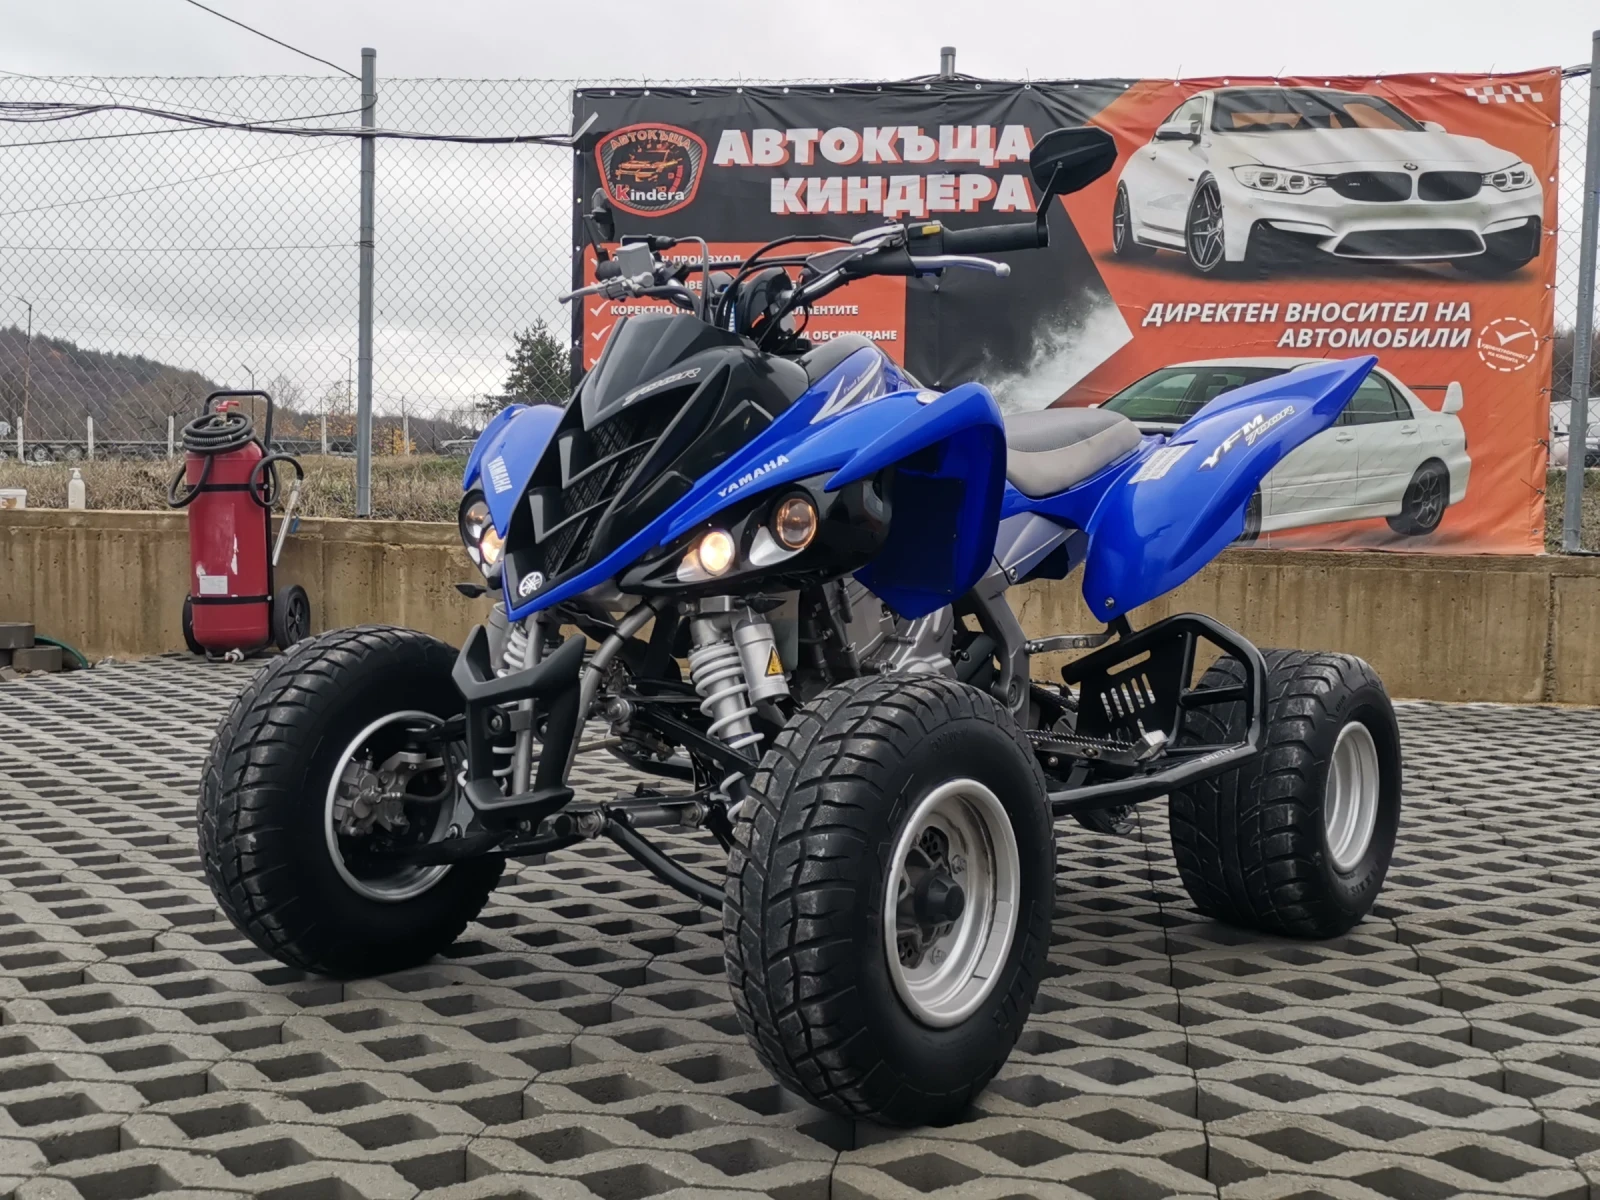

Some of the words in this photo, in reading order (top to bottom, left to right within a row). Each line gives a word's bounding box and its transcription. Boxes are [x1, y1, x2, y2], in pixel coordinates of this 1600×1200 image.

[610, 130, 691, 150] АВТОКЪЩА
[713, 125, 1033, 167] АВТОКЪЩА
[615, 184, 685, 201] Kindera
[771, 174, 1034, 217] КИНДЕРА
[611, 305, 673, 315] КОРЕКТНО
[1142, 302, 1279, 327] ДИРЕКТЕН
[1284, 301, 1429, 323] ВНОСИТЕЛ
[1434, 302, 1472, 322] НА
[1277, 327, 1472, 348] АВТОМОБИЛИ
[1197, 413, 1265, 471] YFM
[487, 455, 513, 495] YAMAHA
[717, 453, 790, 498] YAMAHA
